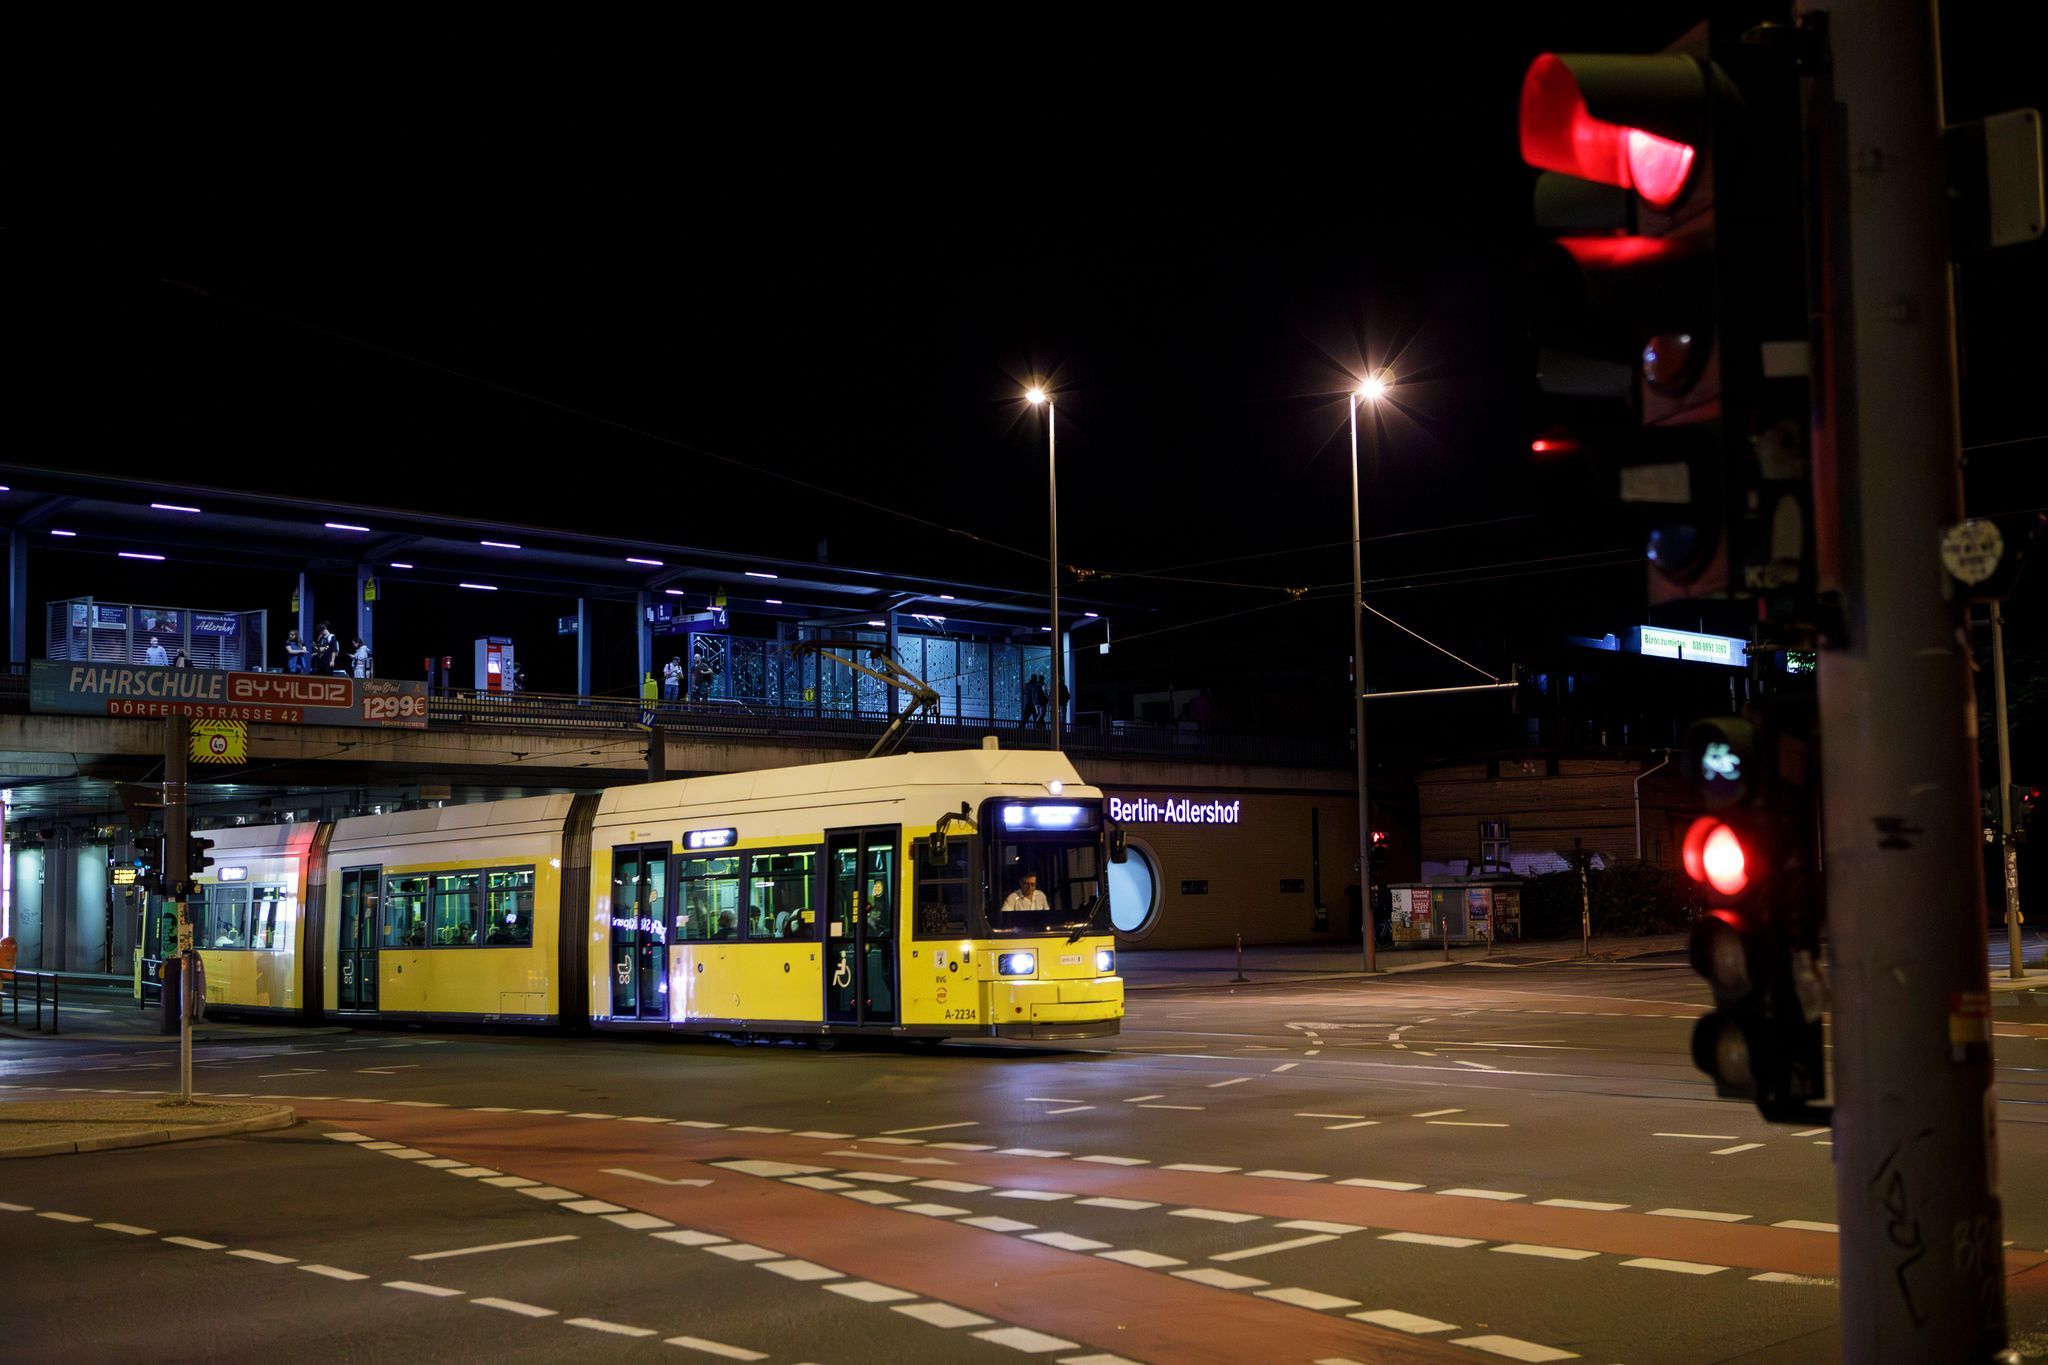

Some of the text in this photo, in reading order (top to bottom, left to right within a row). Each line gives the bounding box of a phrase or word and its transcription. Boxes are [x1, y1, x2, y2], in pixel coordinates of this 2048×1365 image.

[718, 610, 727, 625] 4
[69, 667, 223, 700] FAHRSCHULE
[272, 680, 346, 702] YILDIZ
[363, 695, 425, 719] 1299€
[281, 711, 299, 722] 42
[642, 710, 655, 726] W
[1109, 796, 1240, 824] Berlin-Adlershof
[945, 1008, 976, 1020] A-2234
